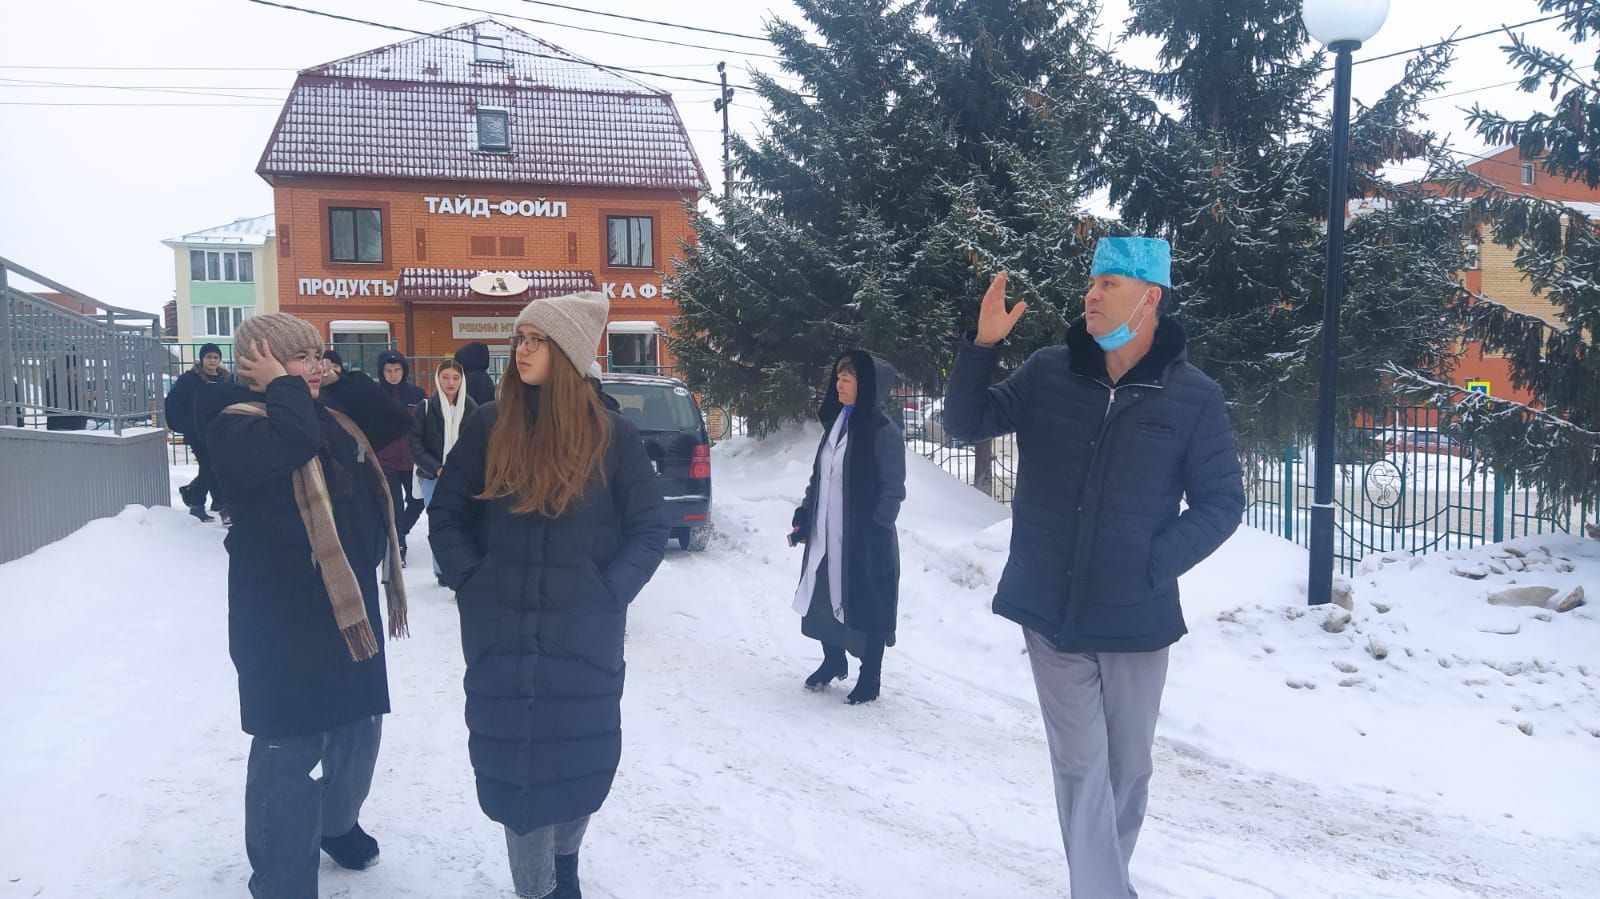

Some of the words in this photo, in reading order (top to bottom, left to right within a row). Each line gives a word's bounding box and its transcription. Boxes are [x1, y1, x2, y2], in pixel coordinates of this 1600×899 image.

[424, 194, 567, 218] ТАЙД-ФОЙЛ
[299, 278, 398, 298] ПРОДУКТЫ
[602, 282, 673, 299] КАФЕ
